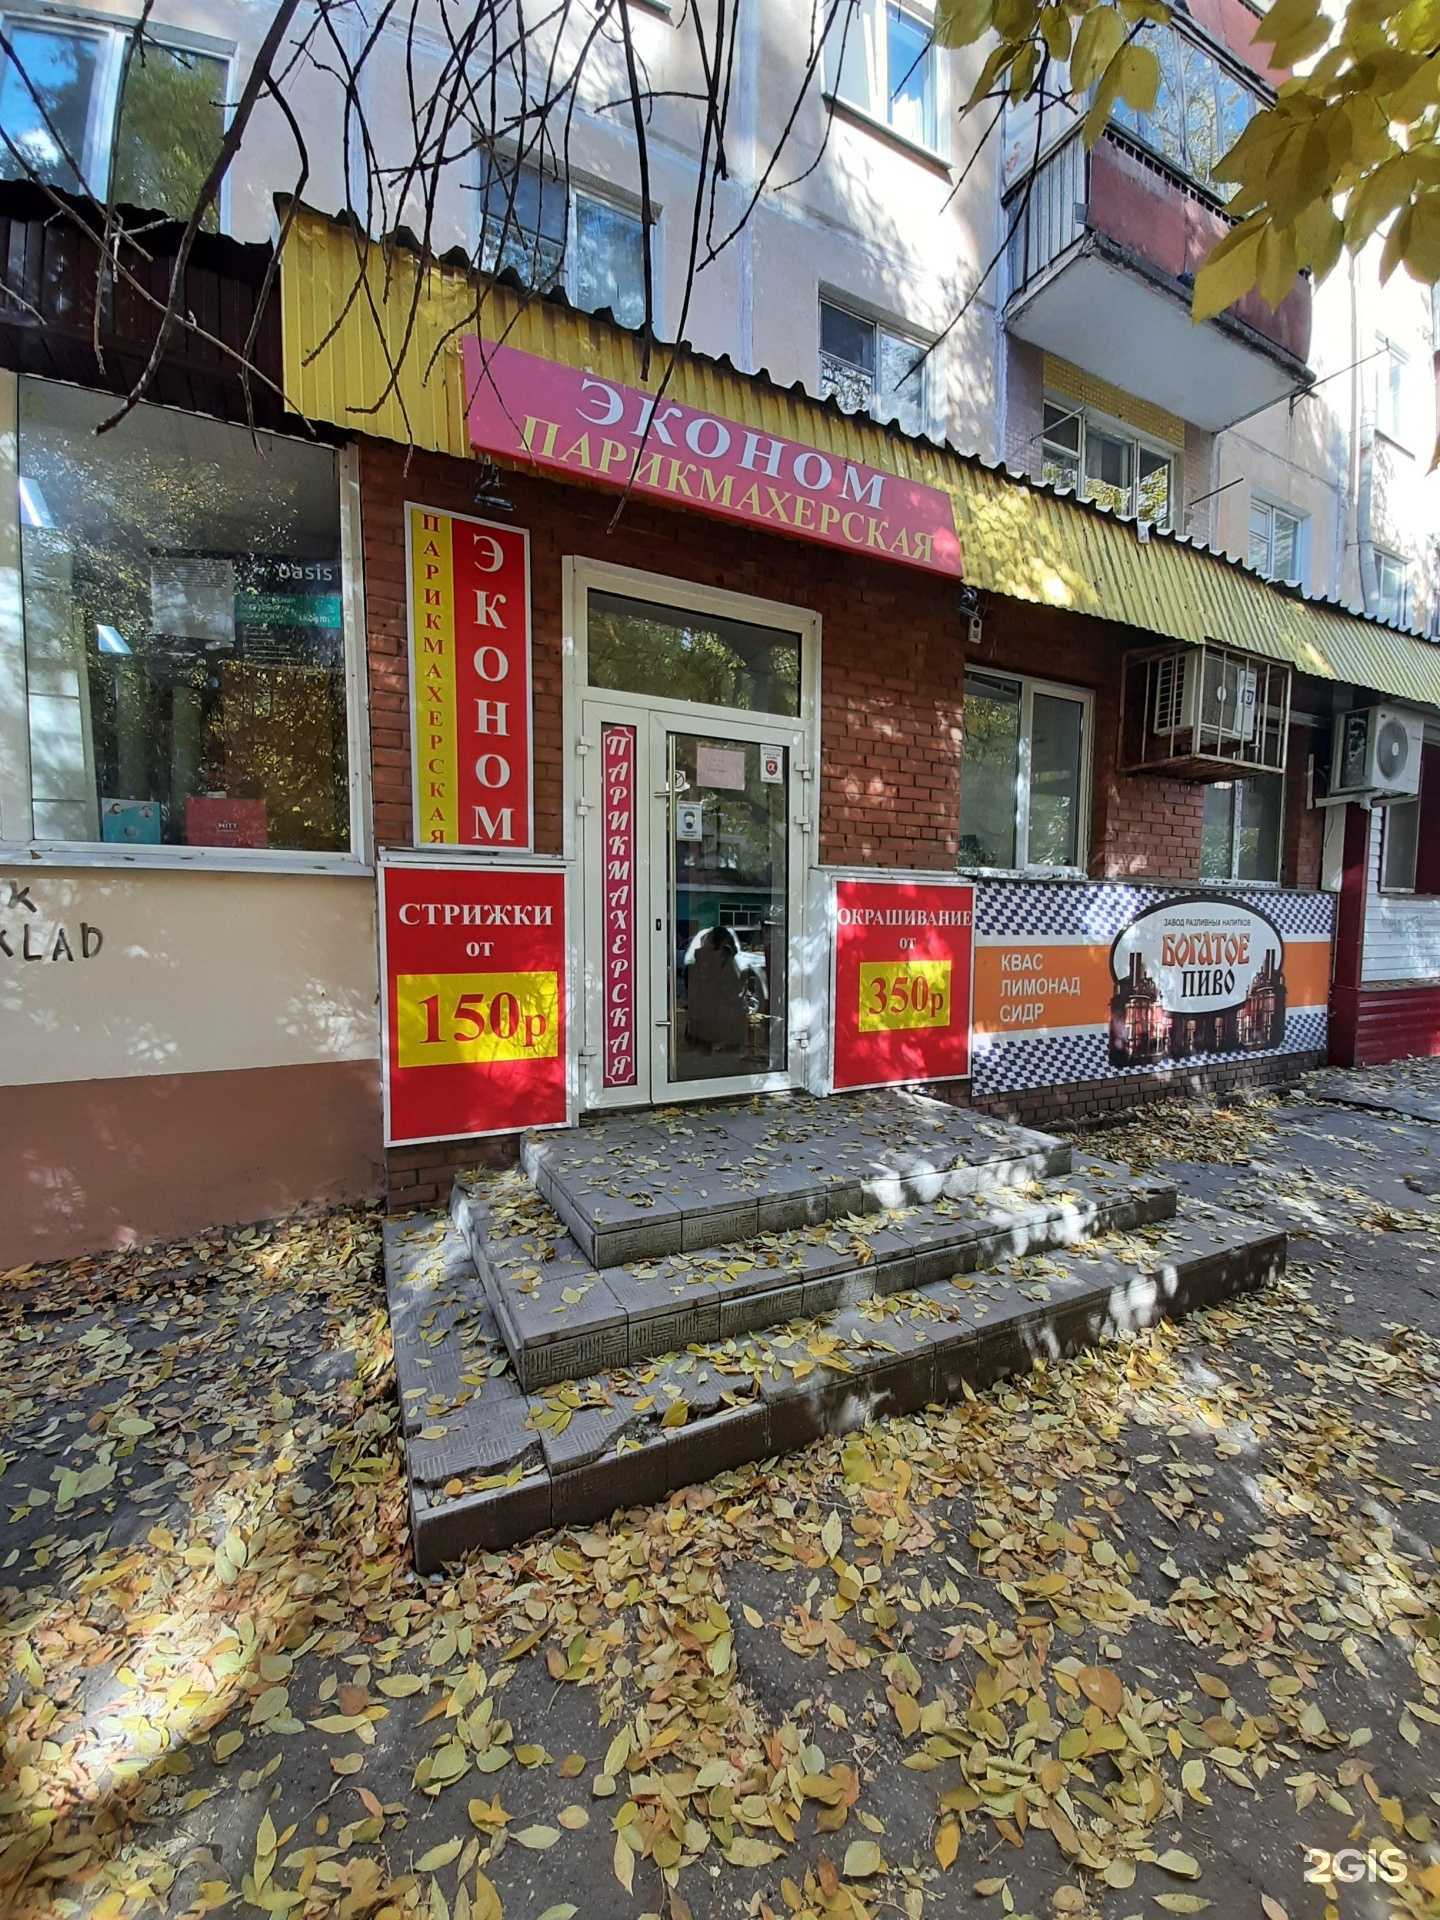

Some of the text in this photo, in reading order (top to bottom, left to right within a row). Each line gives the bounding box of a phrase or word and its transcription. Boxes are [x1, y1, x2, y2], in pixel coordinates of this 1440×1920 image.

[575, 378, 886, 509] ЭКОНОМ
[517, 415, 934, 562] ПАРИКМАХЕРСКАЯ
[422, 513, 445, 844] ПАРИКМАХЕРСКАЯ
[471, 533, 515, 841] ЭКОНОМ
[399, 903, 553, 926] СТРИЖКИ
[606, 735, 633, 1078] ПАРИКМАХЕРСКАЯ
[837, 908, 972, 926] ОКРАШИВАНИЕ
[1163, 918, 1185, 927] ЗАВОД
[466, 941, 495, 957] от
[899, 937, 917, 950] от
[1162, 931, 1250, 968] БОГАТОЕ
[1001, 953, 1044, 971] КВАС
[868, 975, 944, 1018] 350р
[1000, 976, 1081, 997] ЛИМОНАД
[1180, 968, 1235, 998] ПИВО
[418, 991, 548, 1048] 150р
[1000, 1003, 1044, 1024] СИДР
